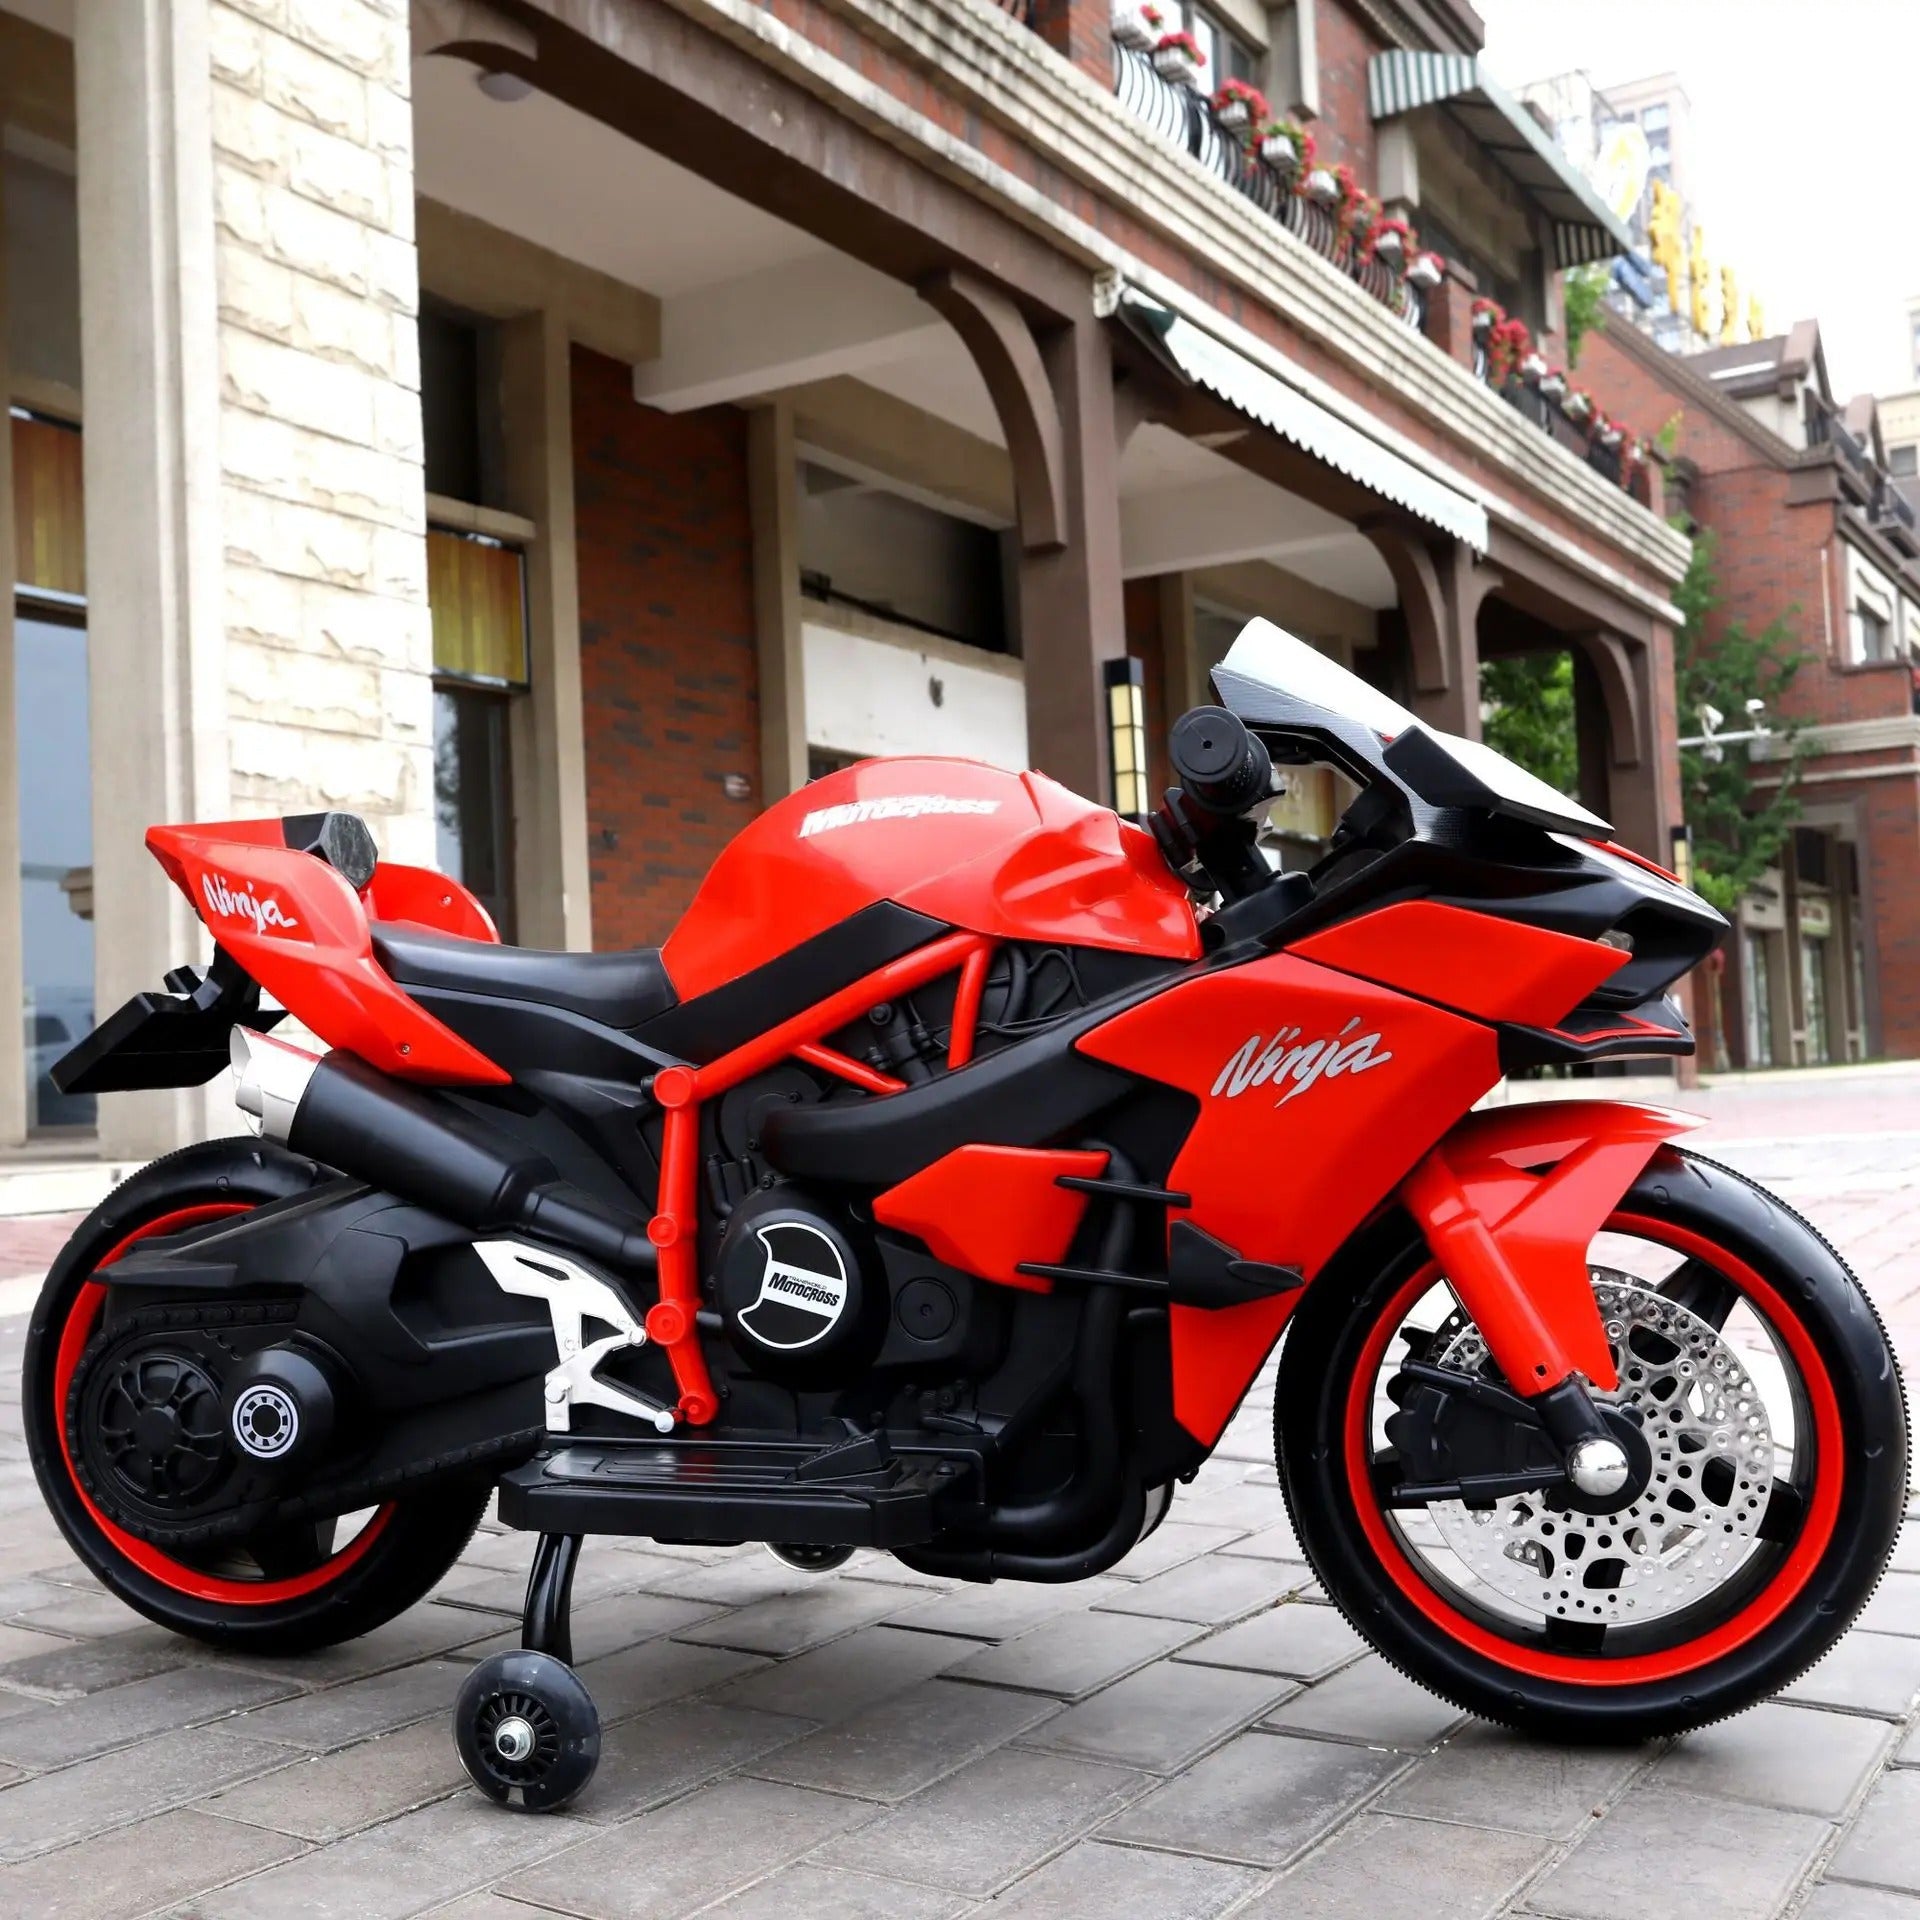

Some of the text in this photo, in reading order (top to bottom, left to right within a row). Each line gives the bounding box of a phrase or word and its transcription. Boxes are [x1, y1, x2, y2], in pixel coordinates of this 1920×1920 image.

[201, 872, 298, 936] Ninja
[1210, 1016, 1393, 1109] Ninja
[767, 1272, 840, 1307] MOTOCROSS
